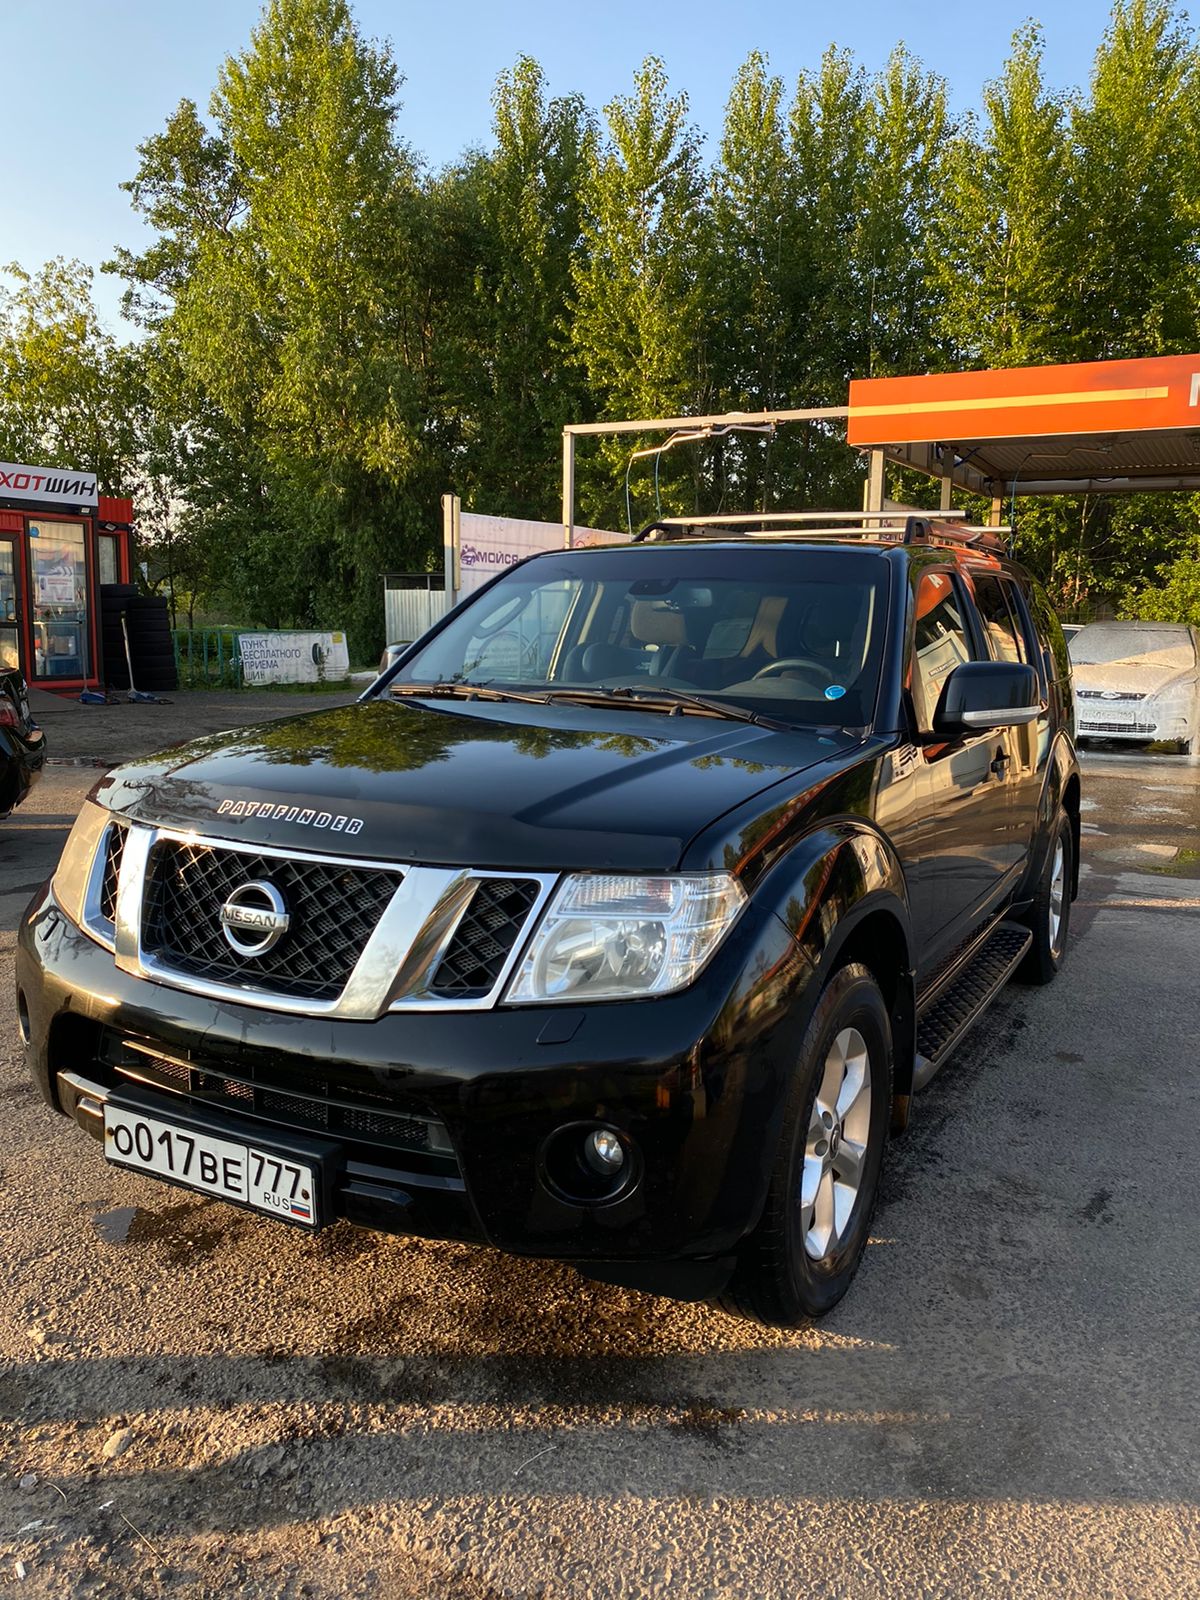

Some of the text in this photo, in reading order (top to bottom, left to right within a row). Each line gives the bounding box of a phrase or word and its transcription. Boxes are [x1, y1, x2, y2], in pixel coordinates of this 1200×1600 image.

[241, 639, 269, 650] ПУНКТ
[243, 649, 301, 660] БЕСПЛАТНОГО
[244, 660, 279, 670] ПРИЕМА
[217, 799, 364, 835] PATHFINDER
[222, 907, 277, 929] NISSAN
[250, 1151, 301, 1200] 777
[263, 1191, 290, 1212] RUS
